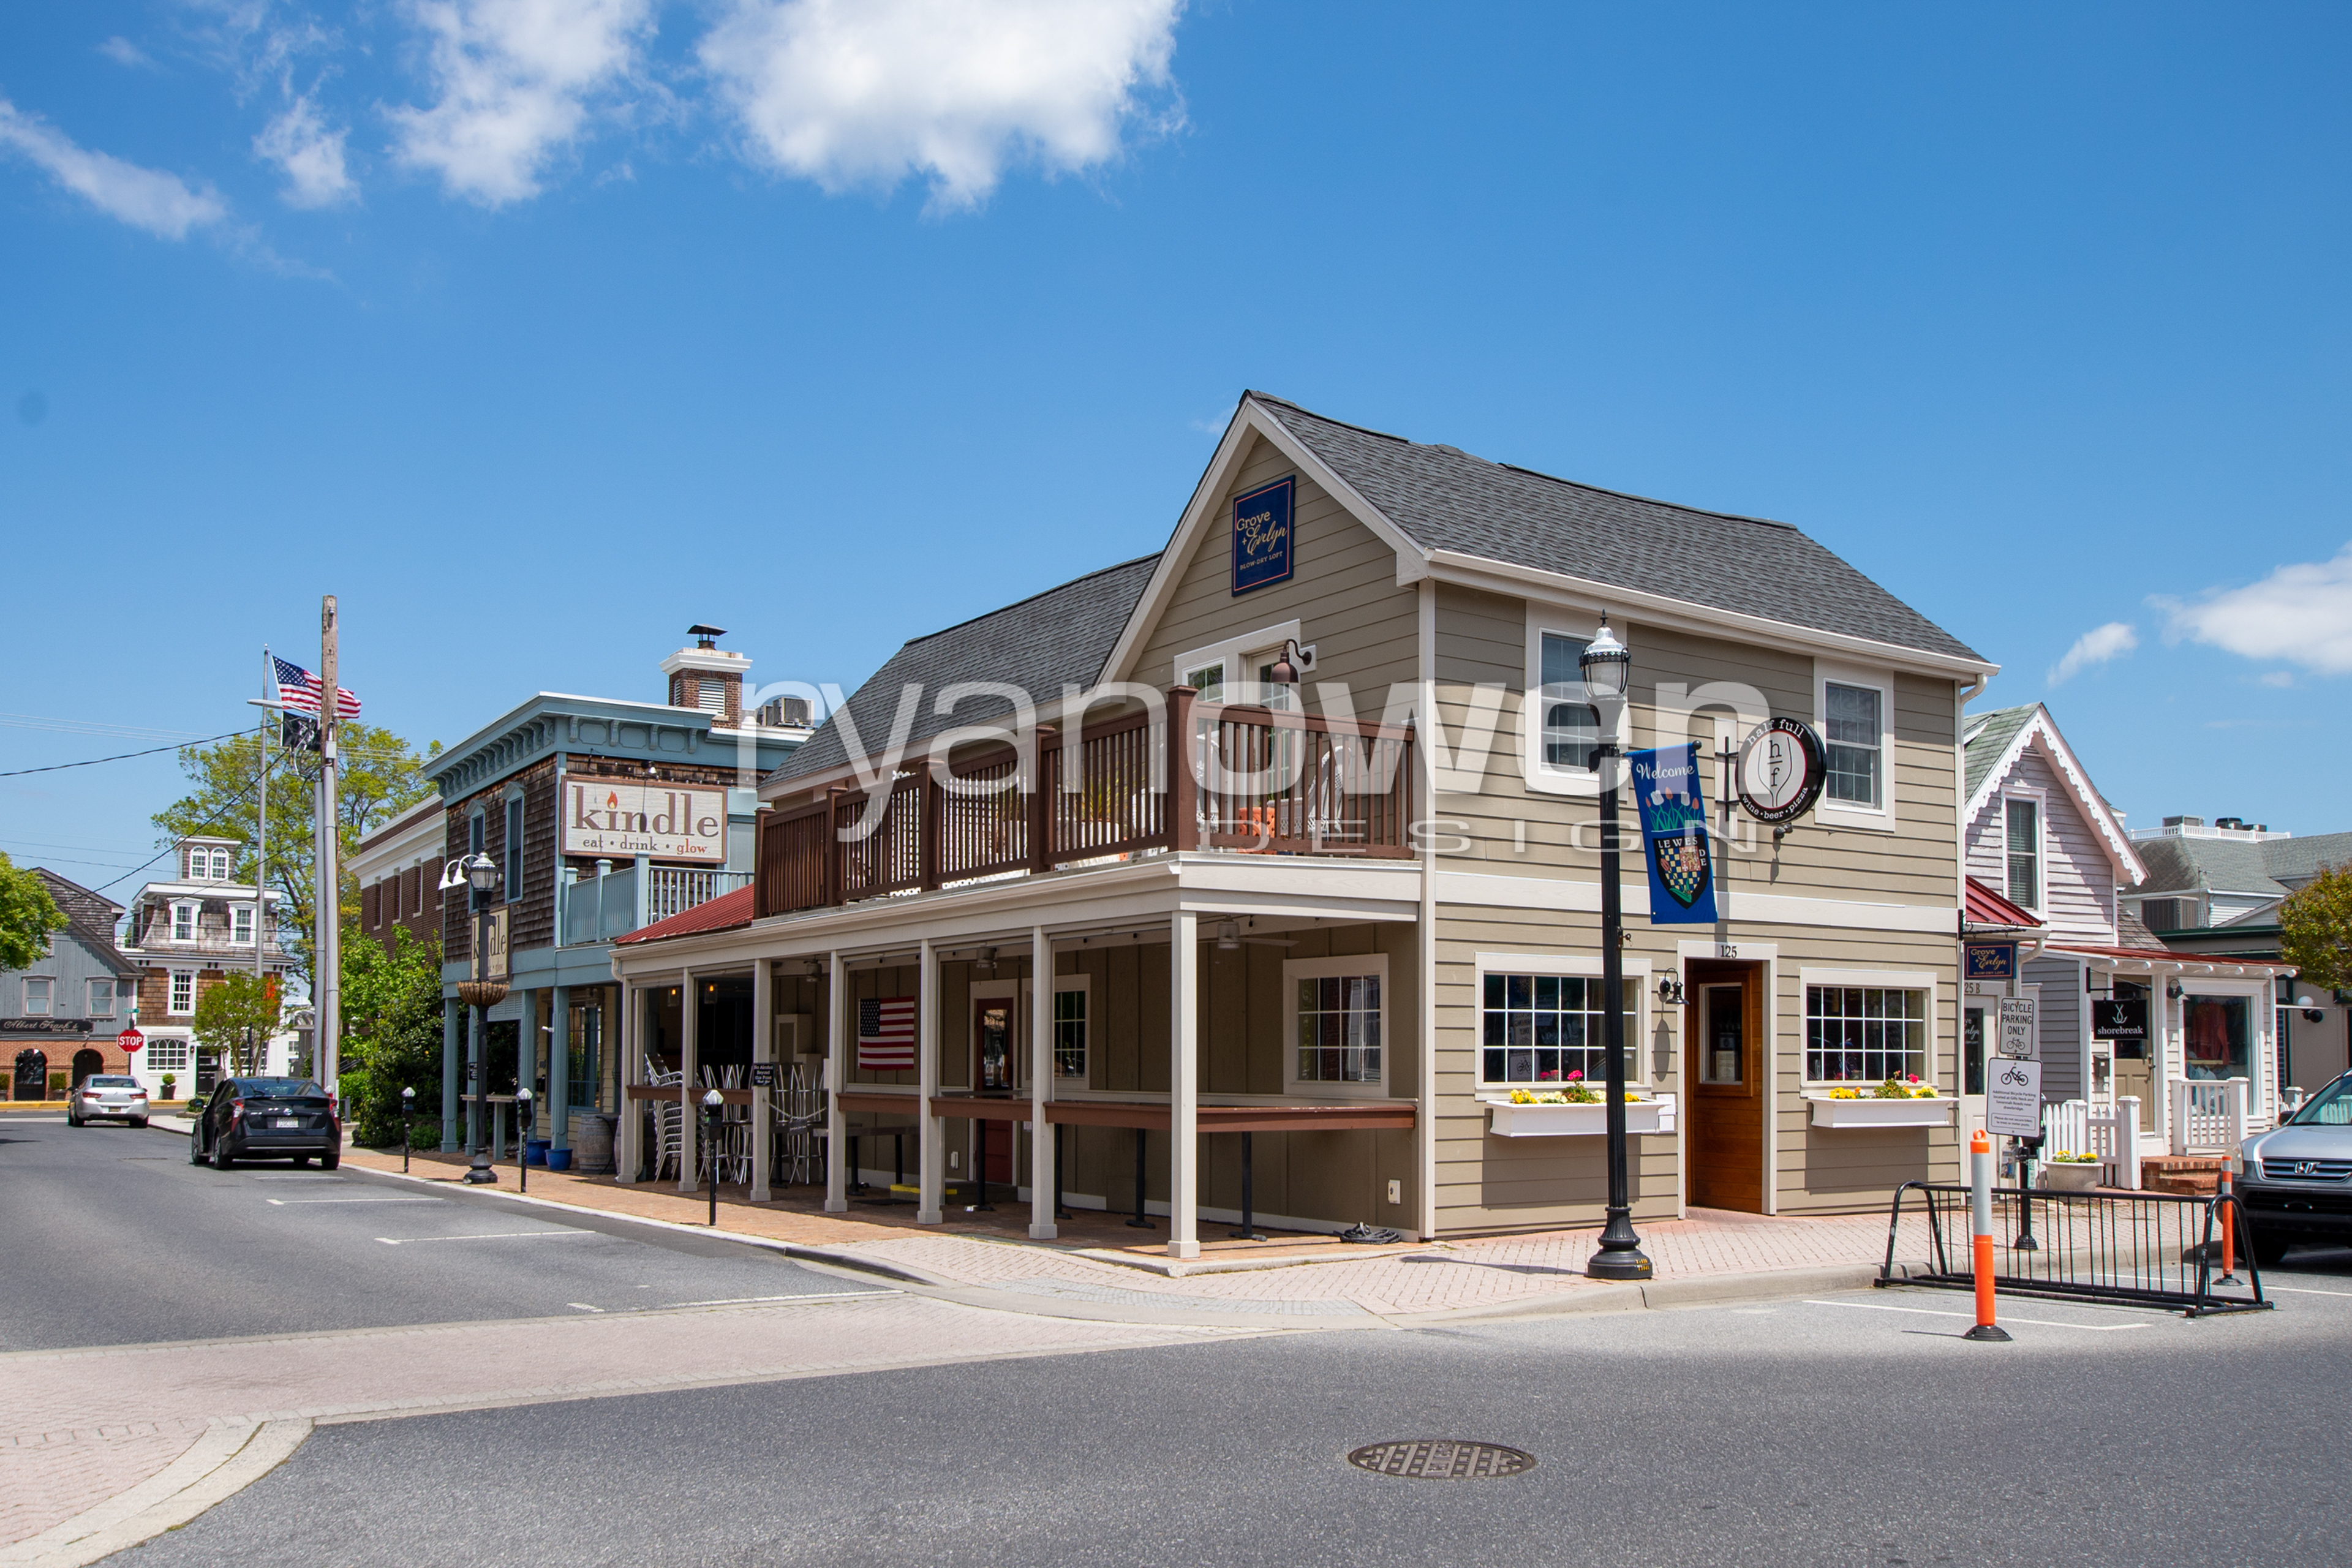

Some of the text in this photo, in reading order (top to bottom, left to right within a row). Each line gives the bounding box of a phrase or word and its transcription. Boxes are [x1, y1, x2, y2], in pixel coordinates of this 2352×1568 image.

[1237, 511, 1270, 531] Grove
[1246, 521, 1287, 556] Evelyn
[1240, 551, 1283, 570] BLOW-DRY LOFT
[1746, 719, 1804, 746] half full
[1769, 740, 1782, 759] h
[1636, 761, 1695, 780] Welcome
[1771, 767, 1780, 787] f
[571, 785, 719, 837] kindle
[1743, 786, 1808, 819] wine beer pizza
[583, 834, 707, 855] eat drink glow
[1657, 836, 1698, 849] LEWES
[473, 914, 507, 960] kdle
[1720, 944, 1738, 959] 125
[1978, 954, 2007, 970] Evelyn
[1976, 982, 1980, 993] B
[2003, 1003, 2032, 1014] BICYCLE
[4, 1020, 37, 1029] Albert
[2002, 1014, 2032, 1025] PARKING
[2007, 1025, 2026, 1036] ONLY
[2097, 1026, 2143, 1035] shorebreak
[119, 1036, 143, 1046] STOP
